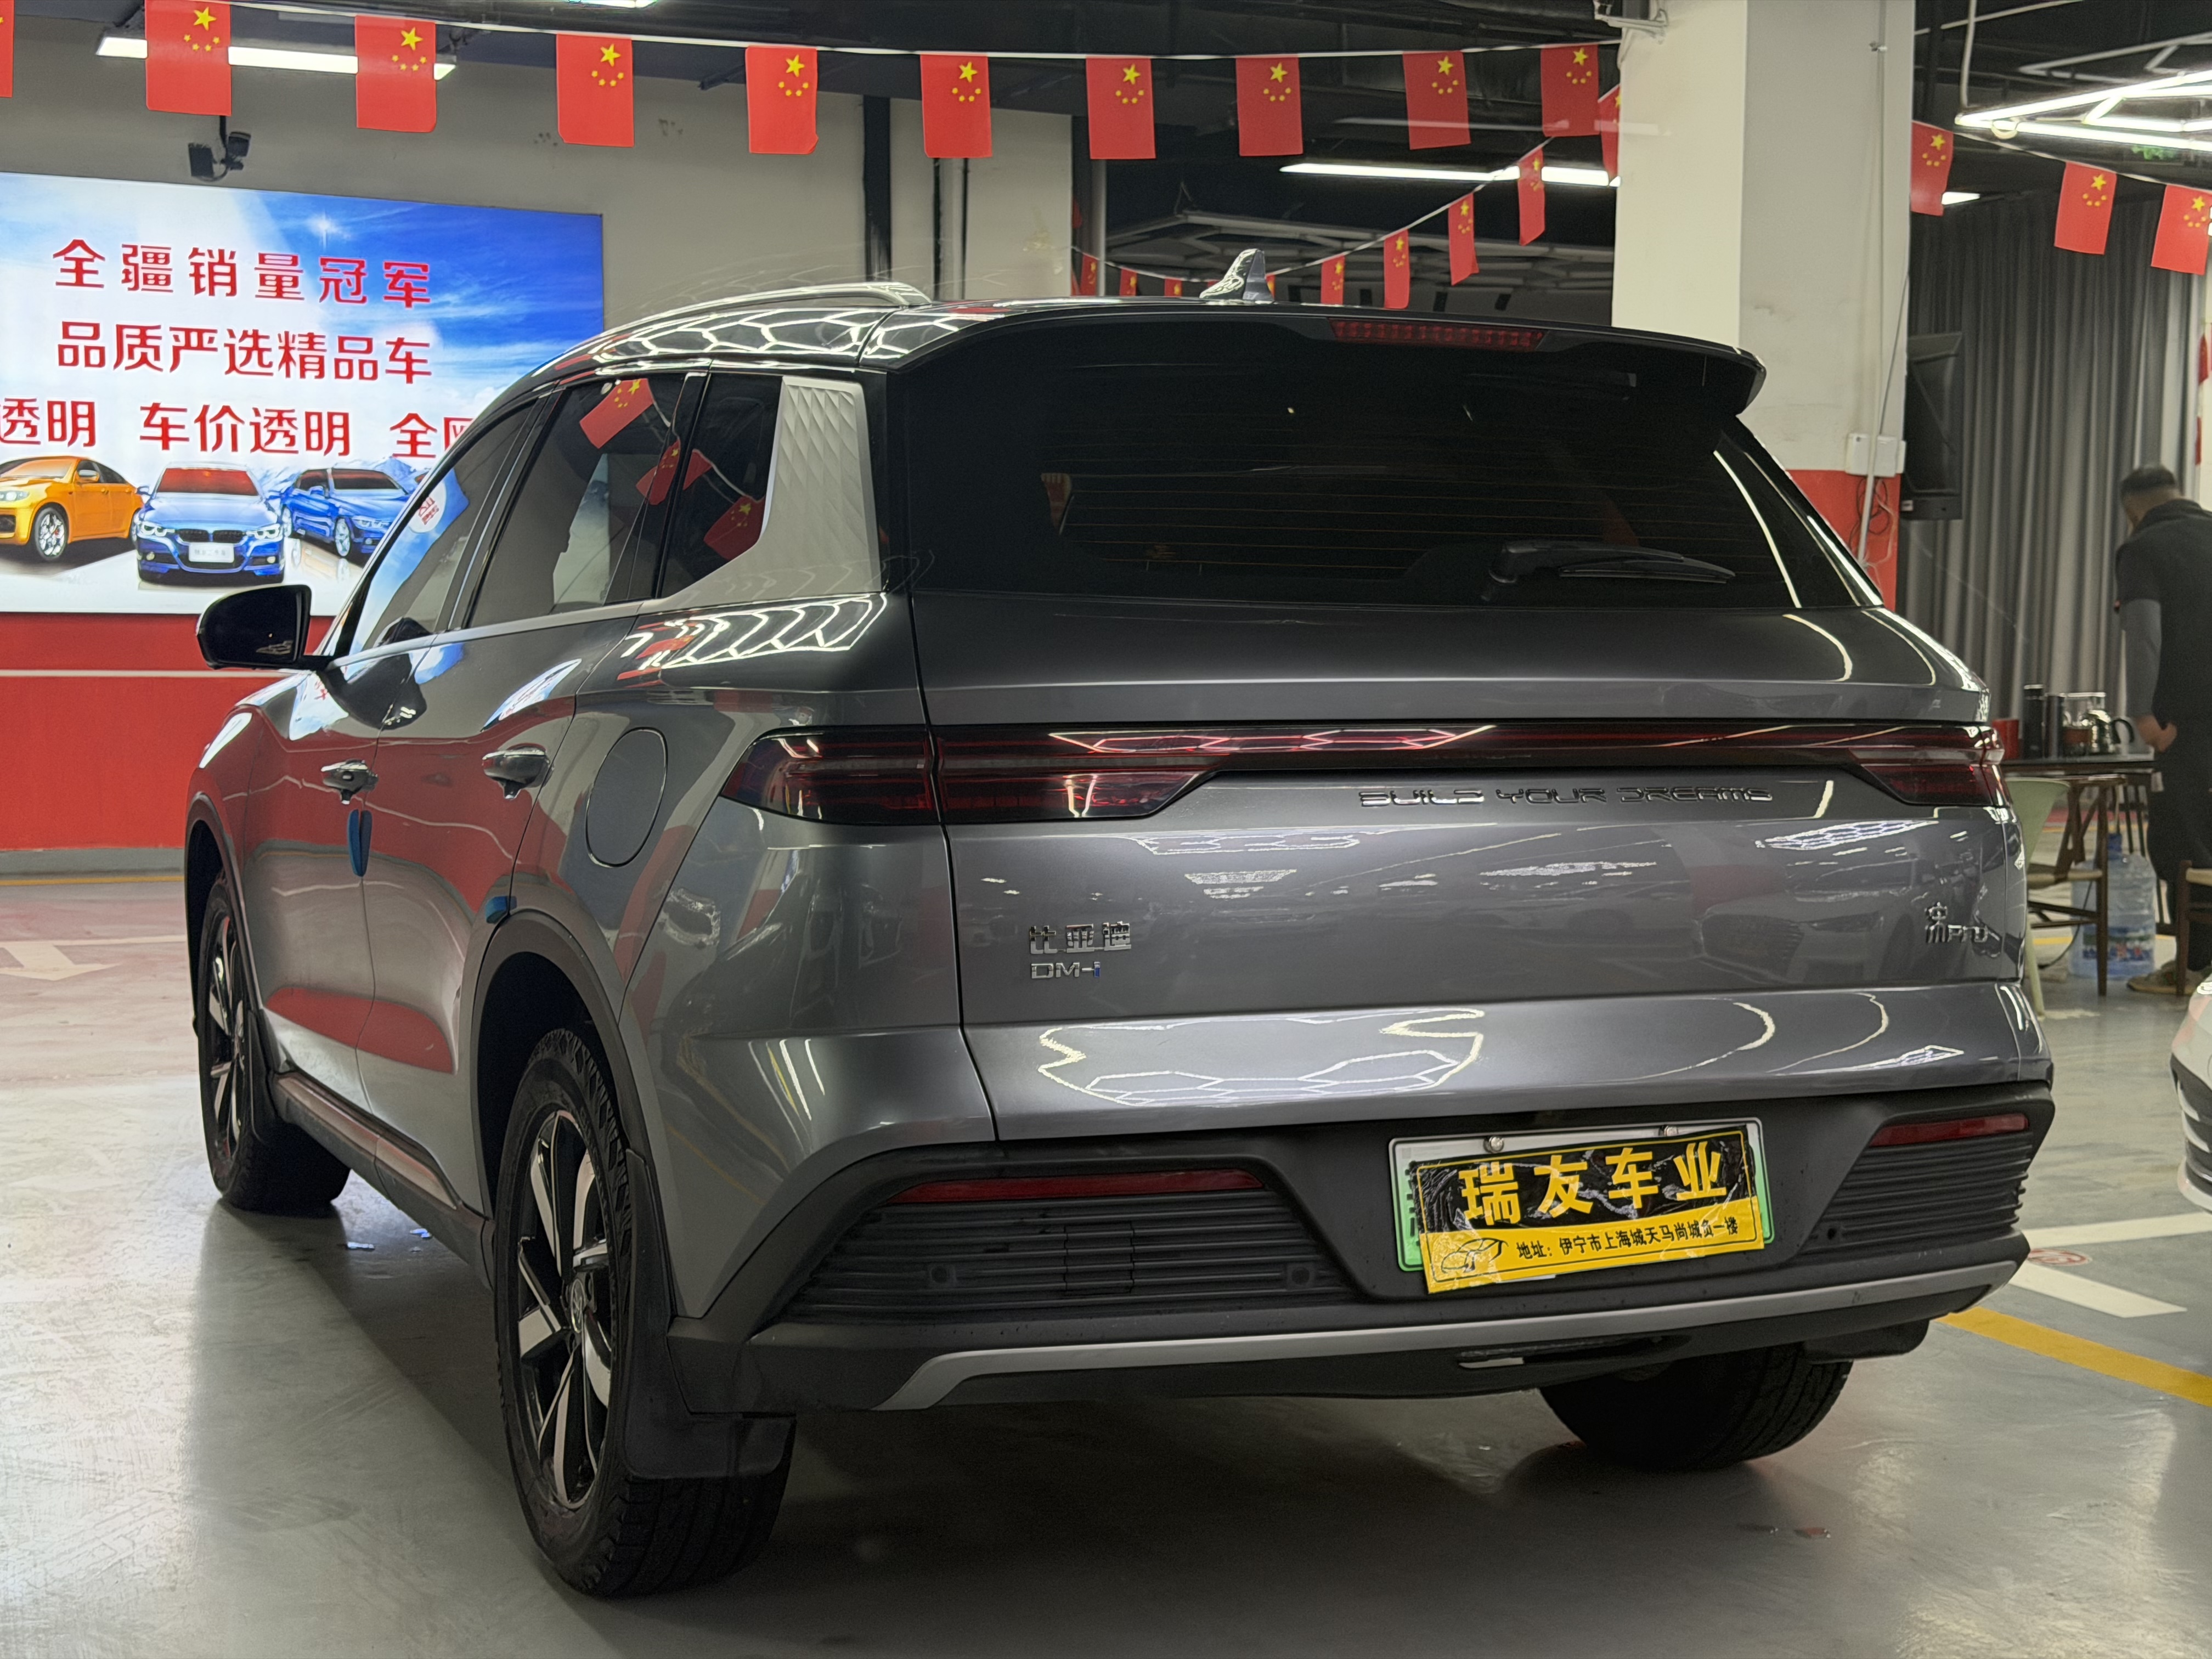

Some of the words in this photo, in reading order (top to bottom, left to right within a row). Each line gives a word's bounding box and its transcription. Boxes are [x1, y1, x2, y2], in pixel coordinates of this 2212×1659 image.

[53, 239, 432, 308] 全疆销量冠军
[58, 321, 432, 385] 品质严选精品车
[139, 402, 351, 456] 车价透明
[1358, 789, 1485, 807] BUILD
[1496, 788, 1607, 804] YOUR
[1620, 787, 1773, 803] DREAMS
[1029, 921, 1132, 954] 比亚迪
[1031, 961, 1101, 979] DM-i
[1458, 1141, 1726, 1226] 瑞友车业
